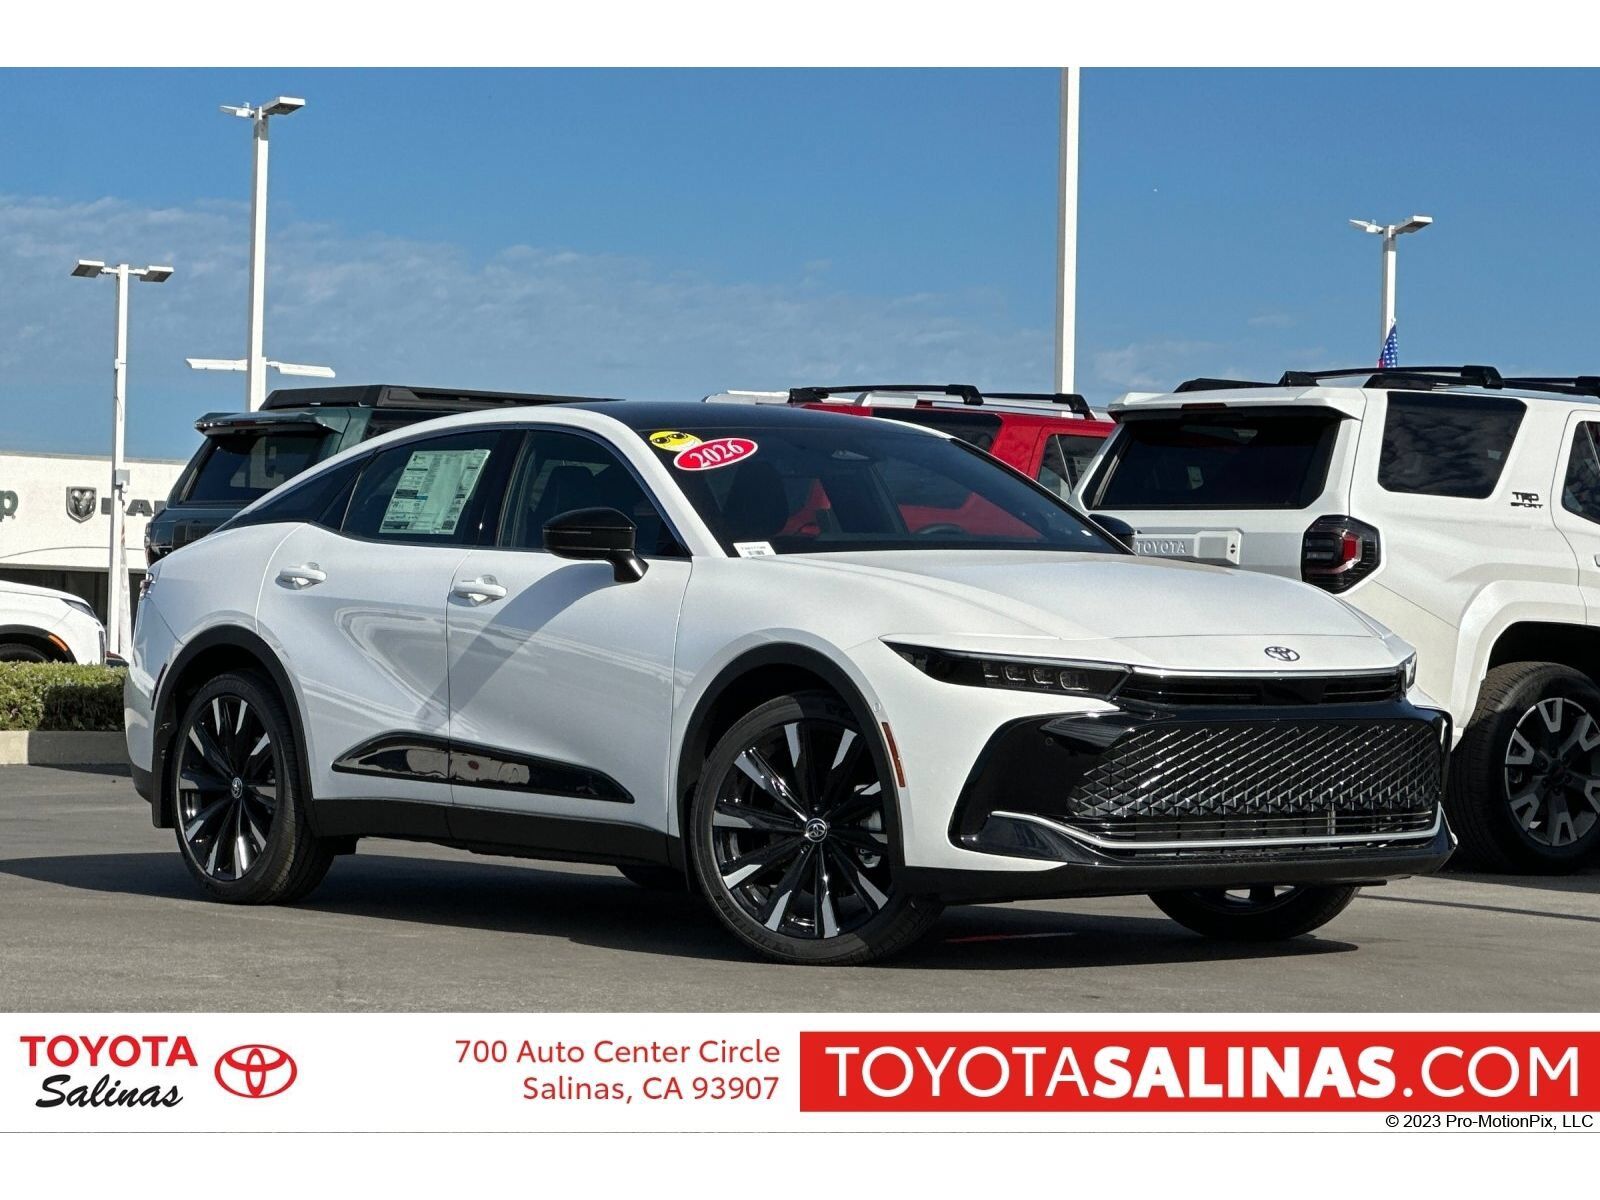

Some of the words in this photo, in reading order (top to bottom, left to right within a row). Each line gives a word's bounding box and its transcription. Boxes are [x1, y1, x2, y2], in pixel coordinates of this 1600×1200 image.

[689, 439, 745, 468] 2026
[1511, 491, 1540, 503] TRD
[1136, 540, 1186, 554] TOYOTA
